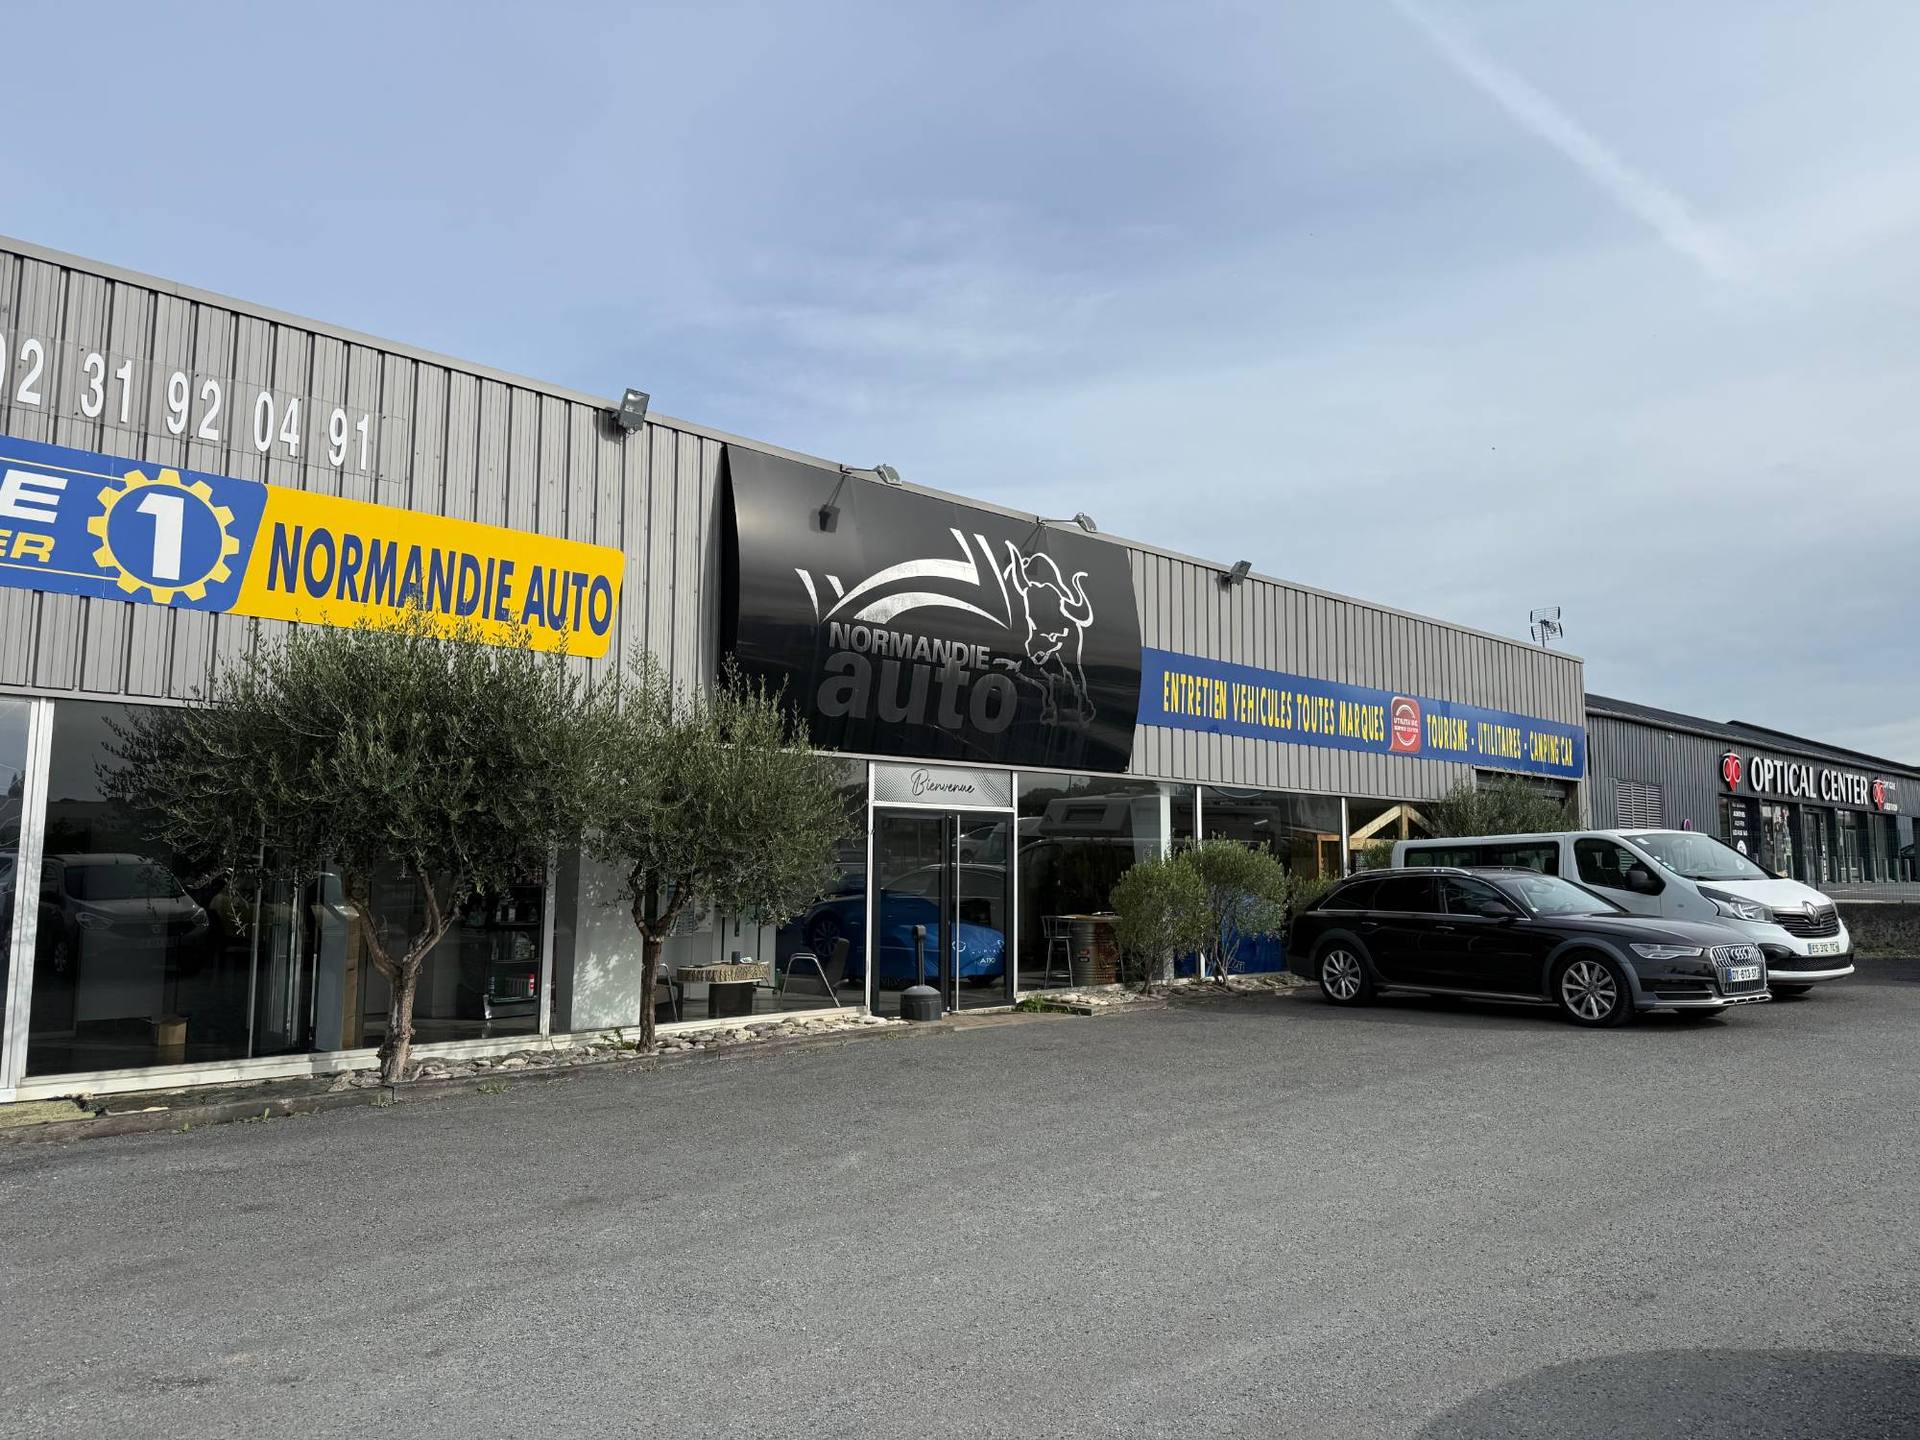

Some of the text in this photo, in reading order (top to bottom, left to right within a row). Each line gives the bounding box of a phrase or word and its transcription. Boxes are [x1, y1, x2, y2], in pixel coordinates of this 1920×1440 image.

[81, 352, 133, 424] 31
[167, 371, 221, 441] 92
[253, 391, 300, 457] 04
[328, 407, 370, 470] 91
[0, 530, 55, 563] R
[137, 492, 184, 581] 1
[267, 522, 613, 637] NORMANDIE AUTO
[829, 621, 990, 671] NORMANDIE
[817, 651, 1019, 734] auto
[1163, 671, 1384, 742] ENTRETIEN VEHICULES TOUTES MARQUES
[1426, 714, 1468, 751] TOURISME
[1477, 722, 1522, 759] UTILITAIRES
[1530, 731, 1559, 764] CAMPING
[1561, 736, 1573, 766] CAR
[911, 768, 975, 796] Bienvenue
[1751, 756, 1868, 805] OPTICAL CENTER
